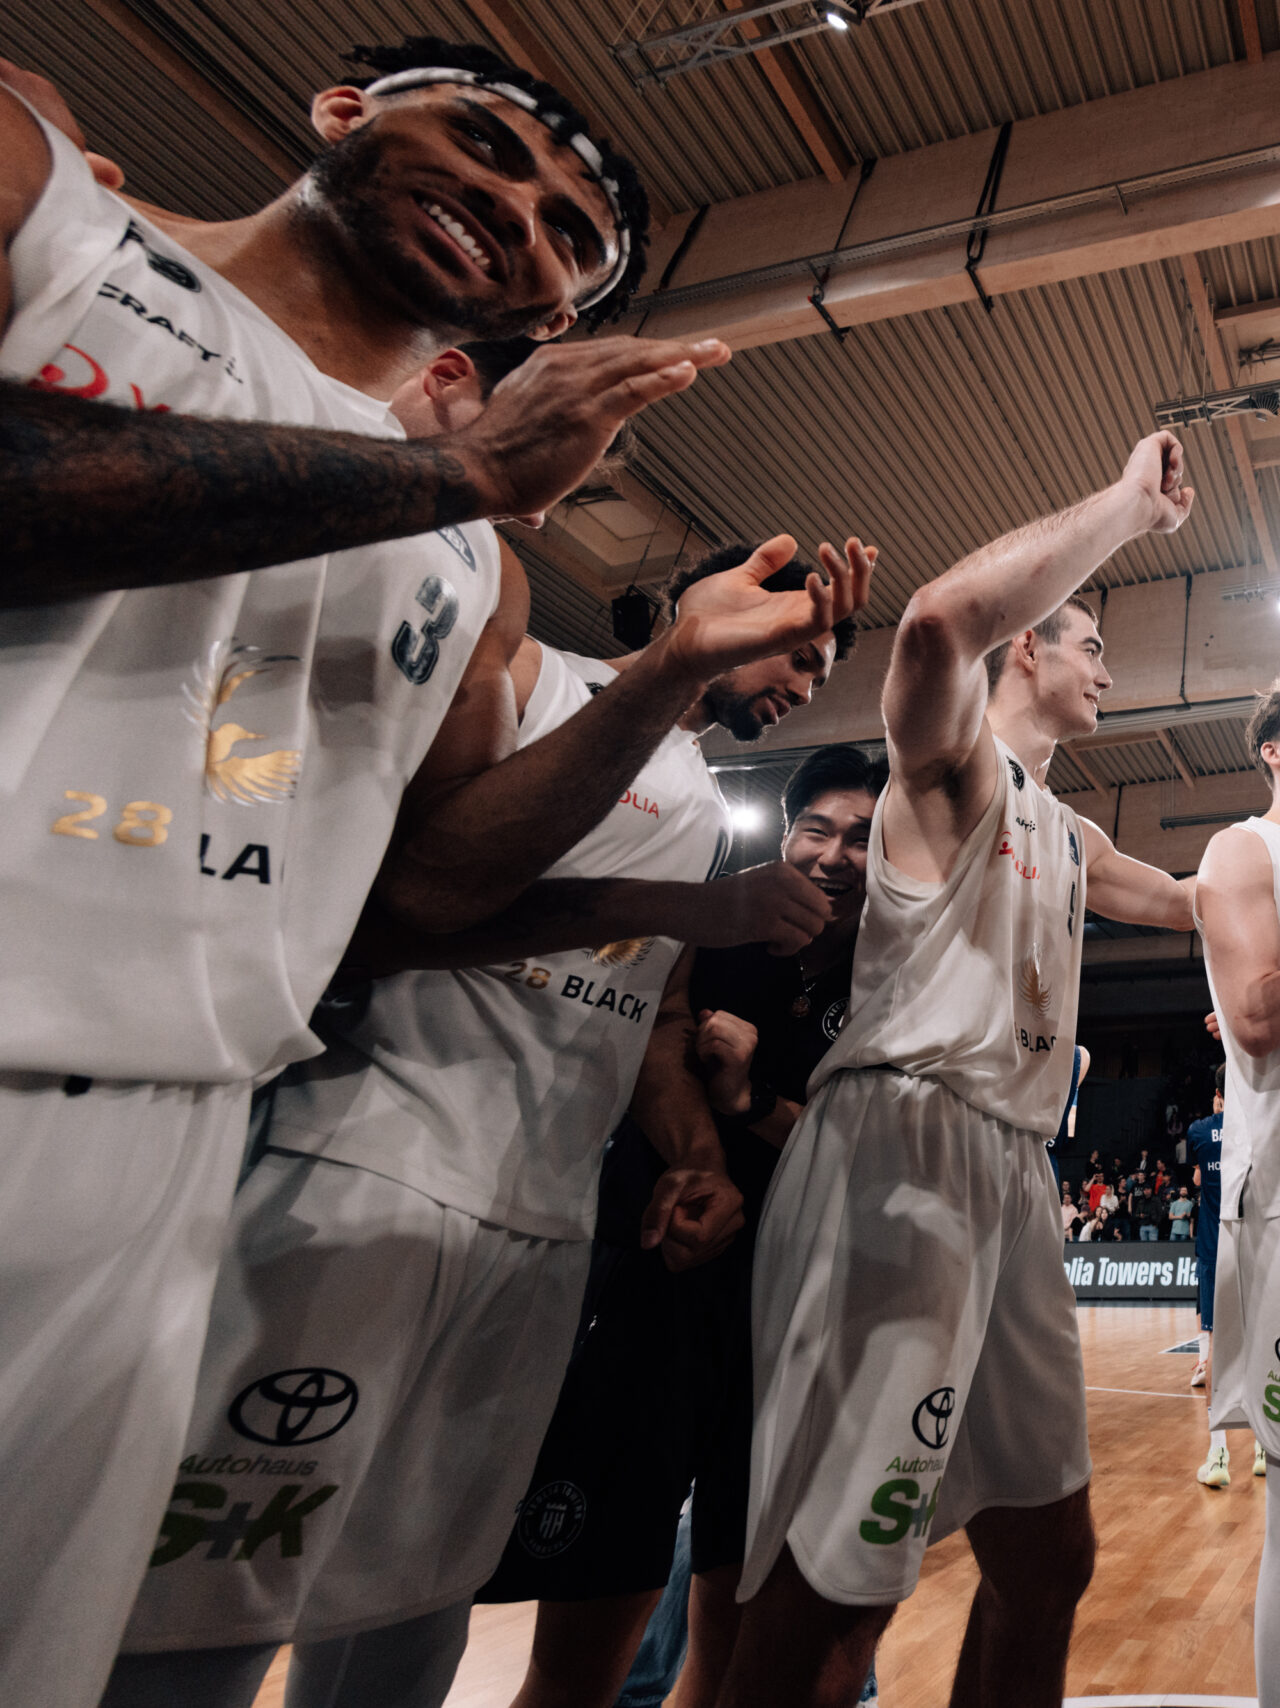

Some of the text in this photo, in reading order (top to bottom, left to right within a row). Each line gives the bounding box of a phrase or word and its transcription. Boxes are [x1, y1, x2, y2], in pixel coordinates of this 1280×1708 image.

[391, 574, 459, 684] 3
[51, 789, 173, 847] 28
[619, 788, 660, 819] OLIA
[504, 961, 649, 1024] 28 BLACK
[1063, 1256, 1199, 1287] olia Towers Ha
[179, 1454, 319, 1475] Autohaus
